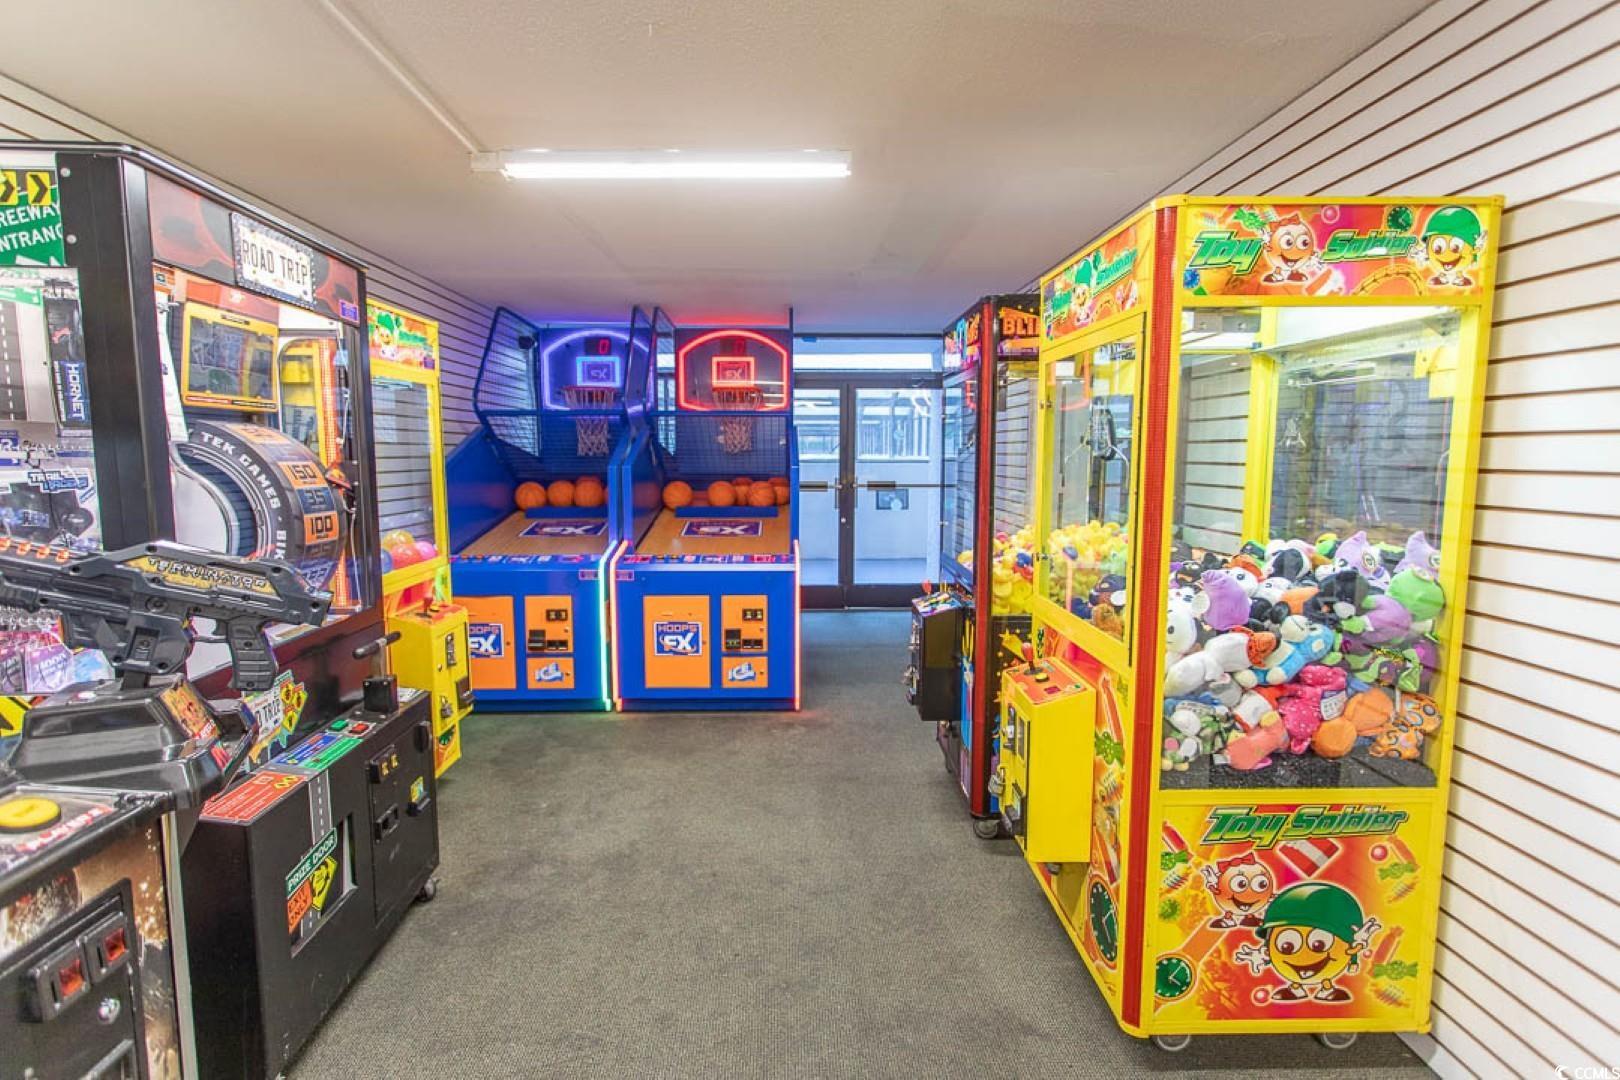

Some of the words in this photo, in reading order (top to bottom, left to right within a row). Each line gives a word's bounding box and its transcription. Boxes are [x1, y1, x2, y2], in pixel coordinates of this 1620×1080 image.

[0, 201, 60, 228] REEWAY
[0, 222, 63, 252] NTRANC
[241, 239, 275, 273] ROAD
[279, 255, 308, 286] TRIP
[1189, 230, 1264, 276] Toy
[1321, 229, 1418, 263] Soldier
[598, 339, 609, 354] 0
[65, 363, 86, 420] HORNET
[200, 431, 237, 455] TEK
[239, 453, 281, 510] GAMES
[288, 463, 317, 481] 150
[310, 515, 333, 535] 100
[469, 626, 500, 635] OOPS
[658, 624, 698, 632] HOOPS
[1200, 806, 1289, 850] Toy
[1282, 805, 1408, 838] Soldier
[287, 859, 312, 892] PRIZE
[312, 834, 334, 865] DOOR
